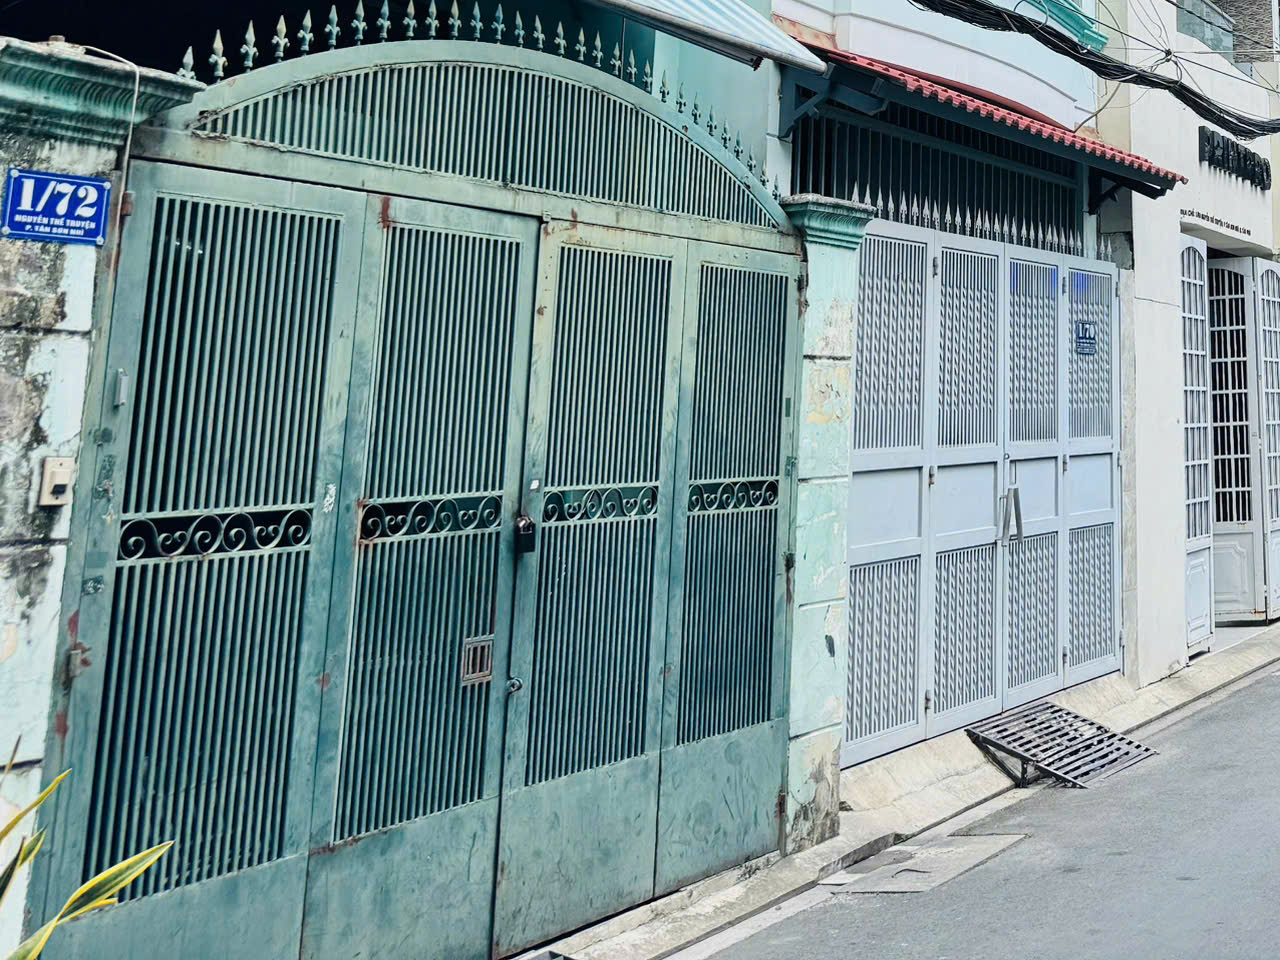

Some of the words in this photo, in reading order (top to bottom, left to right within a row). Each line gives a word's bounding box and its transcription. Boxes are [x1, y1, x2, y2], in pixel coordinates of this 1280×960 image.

[16, 178, 98, 218] 1/72
[50, 217, 65, 226] THẾ
[66, 219, 96, 229] TRUYỆN
[51, 227, 69, 235] SƠN
